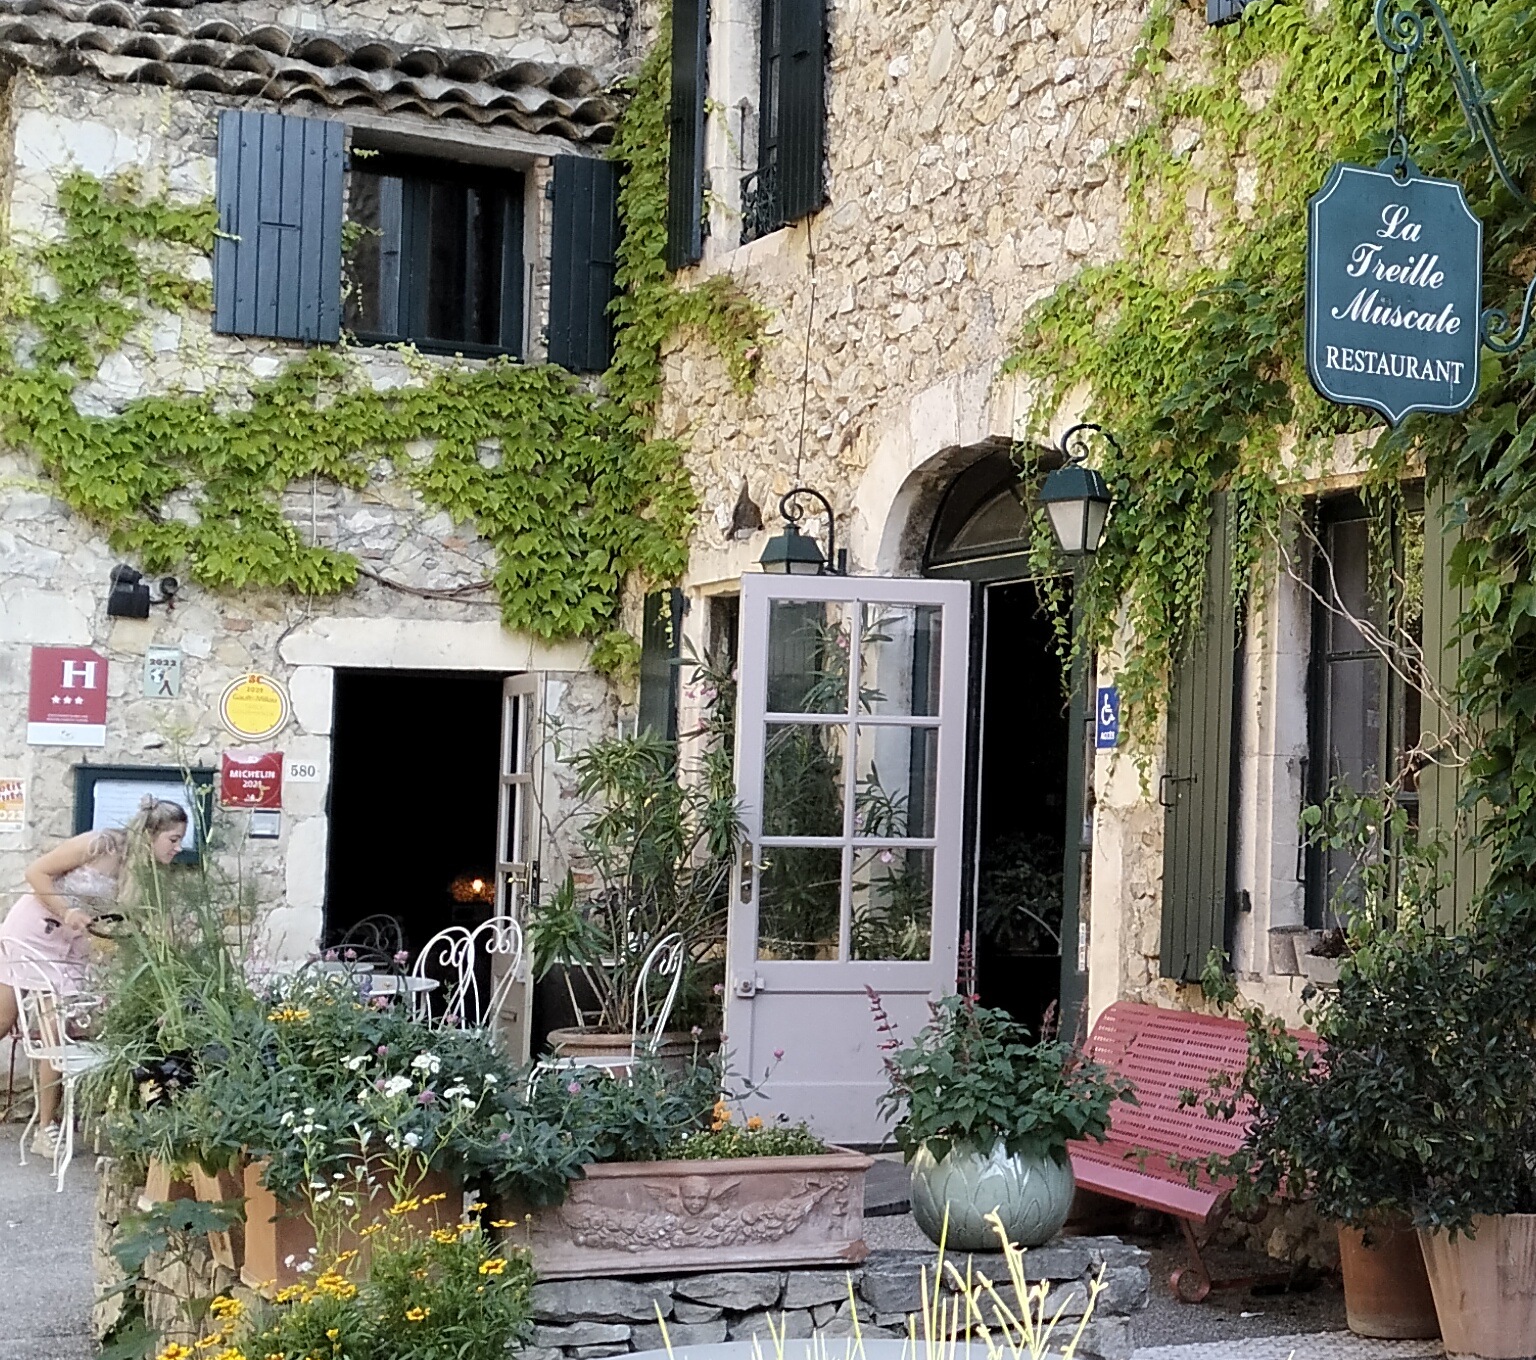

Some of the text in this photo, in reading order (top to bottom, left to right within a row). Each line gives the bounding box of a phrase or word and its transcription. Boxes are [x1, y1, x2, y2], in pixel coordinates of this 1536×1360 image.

[1376, 203, 1422, 242] La
[1347, 242, 1445, 290] Treille
[1326, 345, 1465, 384] RESTAURANT
[60, 659, 98, 689] H
[229, 769, 276, 779] MICHELIN
[290, 764, 316, 777] 580
